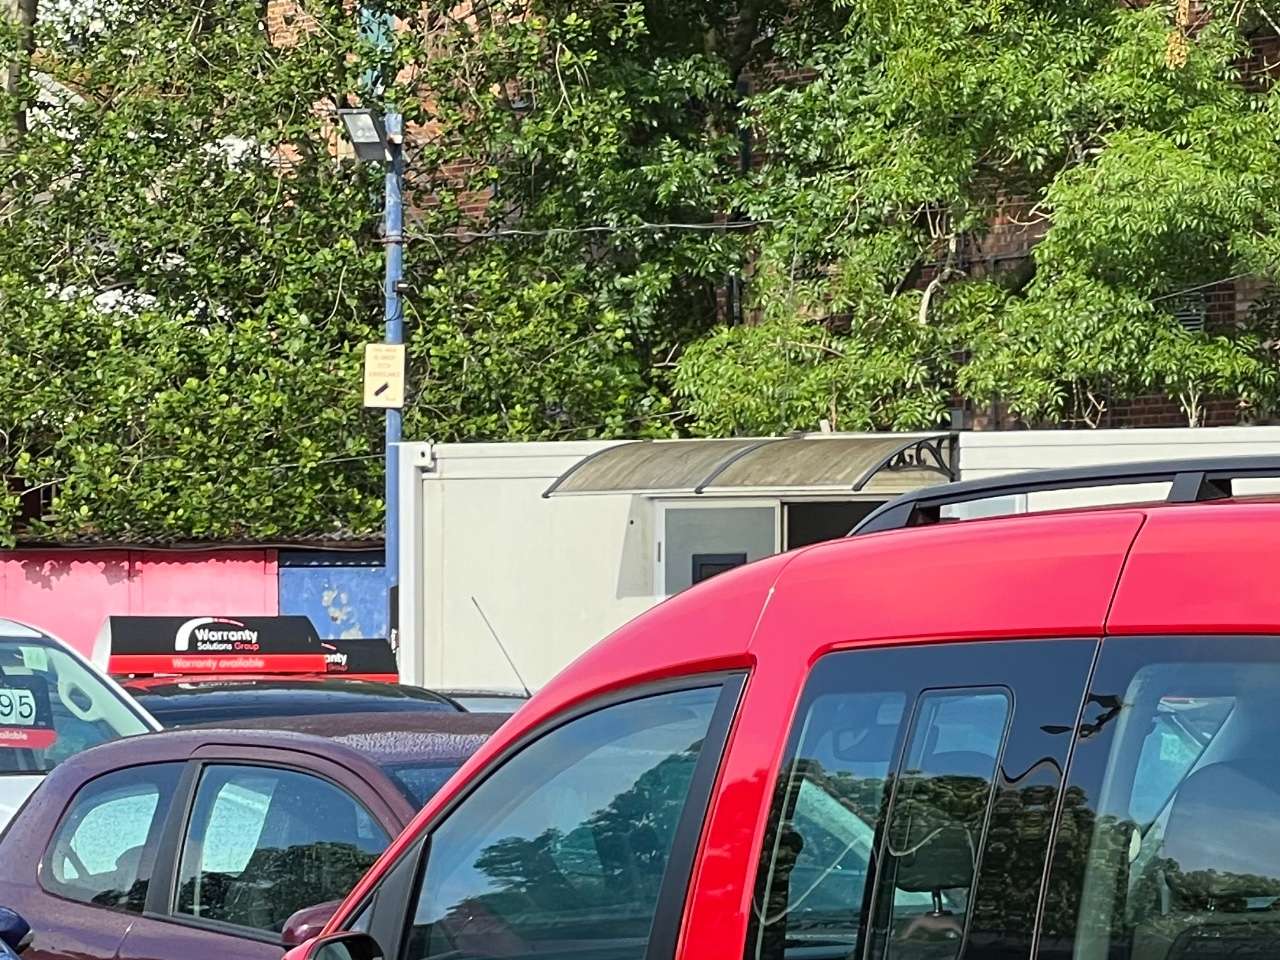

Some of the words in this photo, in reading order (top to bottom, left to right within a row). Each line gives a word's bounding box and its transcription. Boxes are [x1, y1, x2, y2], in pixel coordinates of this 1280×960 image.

[194, 628, 258, 643] Warranty
[197, 641, 233, 651] Solutions
[234, 642, 260, 651] Group
[172, 658, 218, 671] Warranty
[219, 658, 265, 668] available
